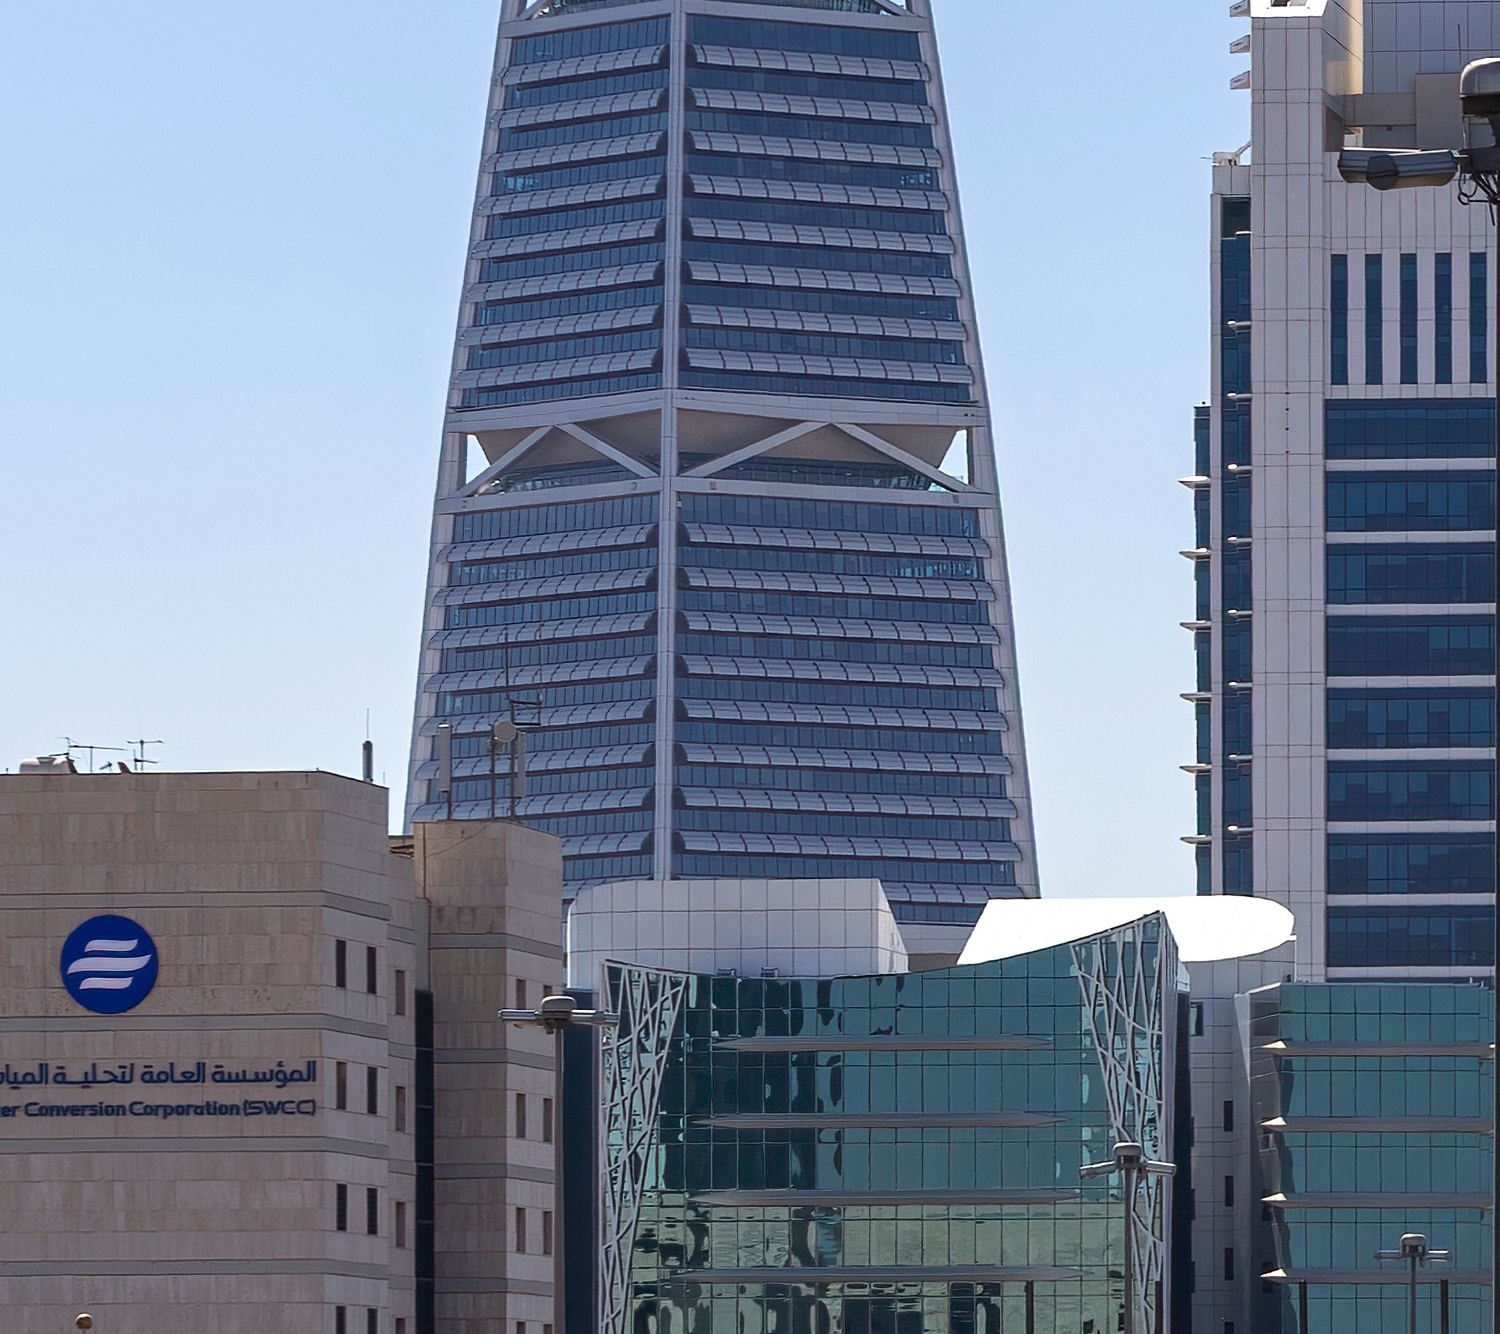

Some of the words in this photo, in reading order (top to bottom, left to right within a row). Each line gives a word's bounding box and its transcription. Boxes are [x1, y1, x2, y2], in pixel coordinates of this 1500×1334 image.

[53, 1062, 135, 1088] لتحلية
[140, 1061, 206, 1084] العامة
[211, 1060, 317, 1088] المؤسسة
[24, 1101, 127, 1117] Conversion
[129, 1101, 240, 1119] Corporation
[242, 1099, 316, 1116] (SWCC)
